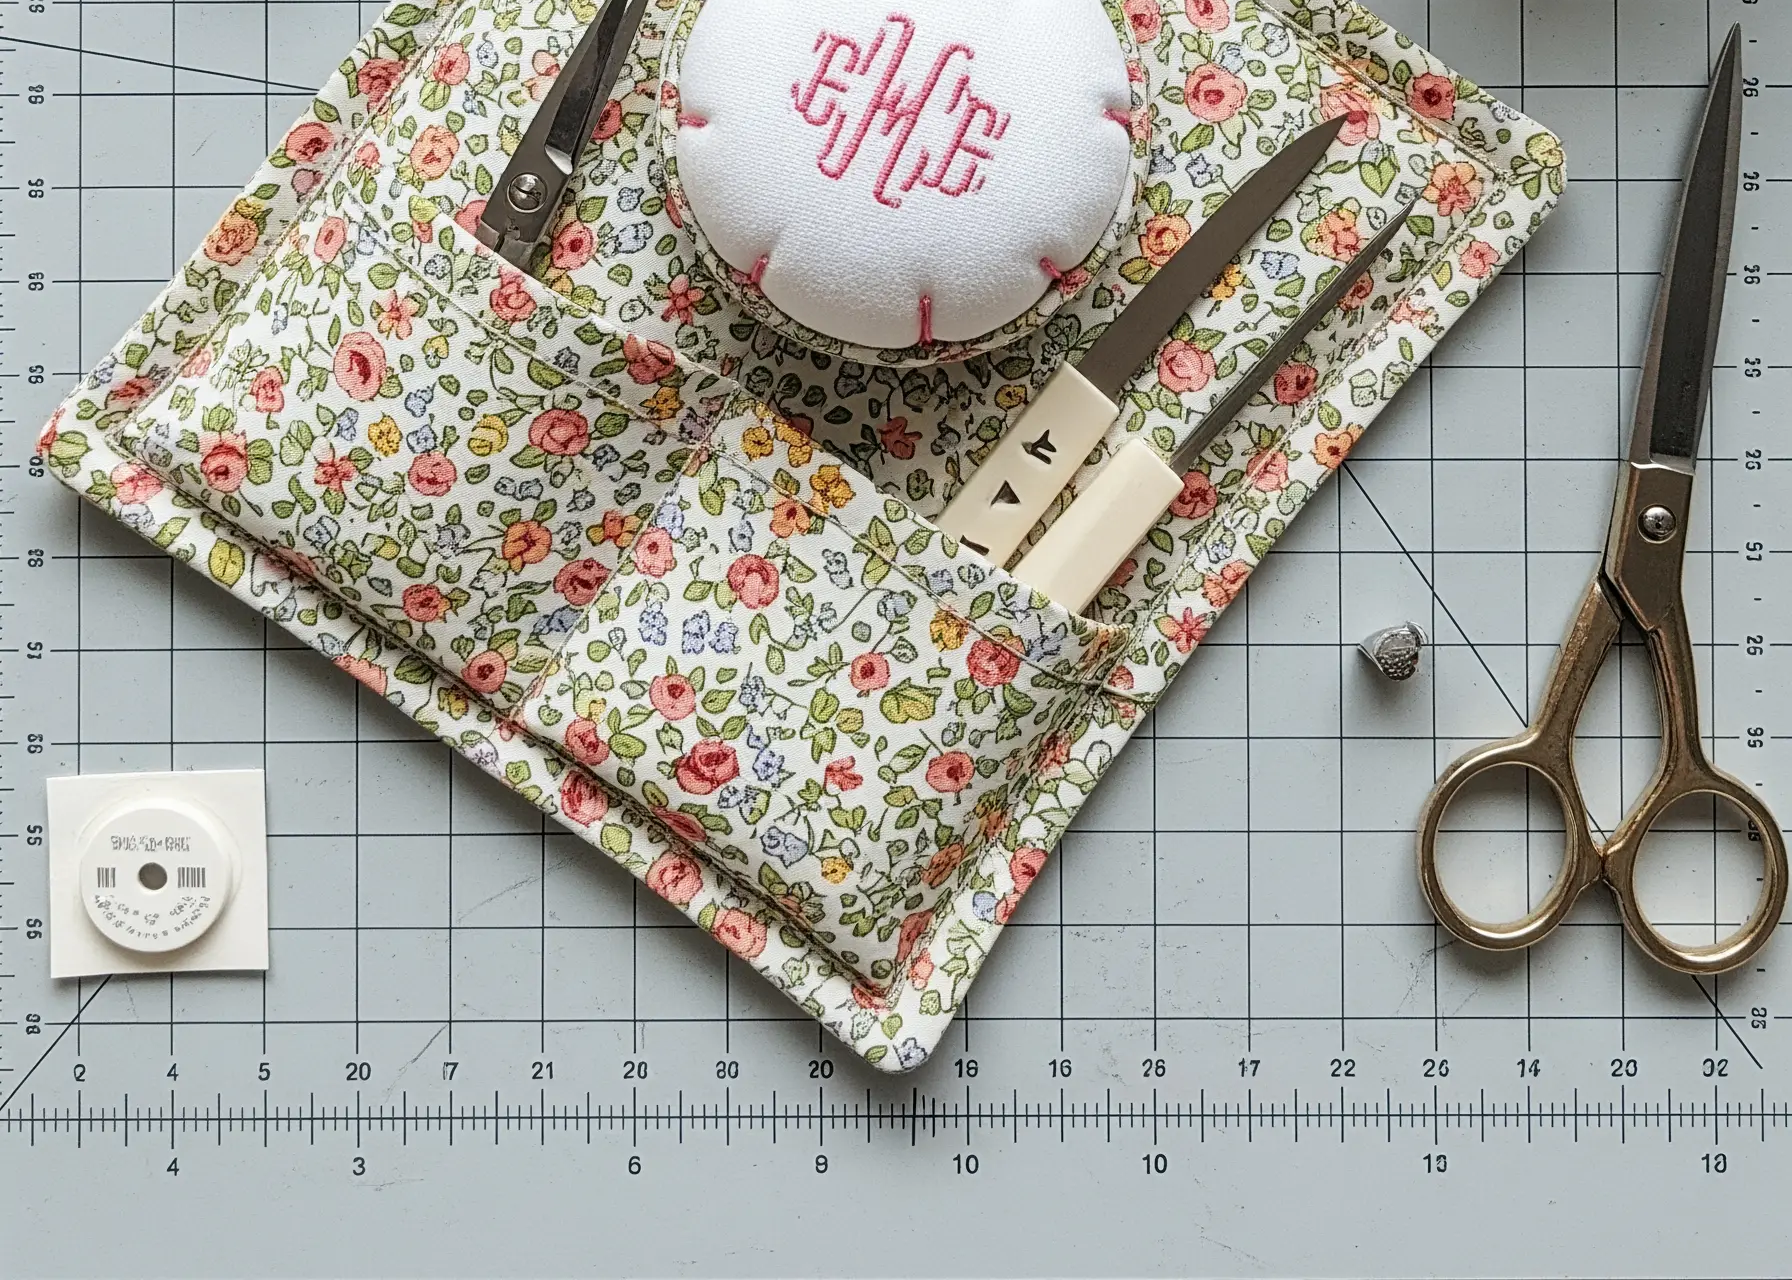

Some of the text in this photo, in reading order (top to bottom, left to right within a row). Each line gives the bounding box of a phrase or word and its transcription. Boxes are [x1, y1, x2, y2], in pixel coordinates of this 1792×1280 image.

[1746, 634, 1764, 656] 26
[166, 1062, 180, 1082] 4
[257, 1062, 271, 1082] 5
[345, 1061, 372, 1082] 20
[531, 1061, 554, 1080] 21
[807, 1059, 834, 1080] 20
[1048, 1058, 1073, 1079] 16
[1329, 1058, 1356, 1078] 22
[166, 1156, 180, 1177] 4
[352, 1156, 366, 1177] 3
[627, 1155, 642, 1176] 6
[952, 1153, 980, 1175] 10
[1141, 1153, 1168, 1175] 10
